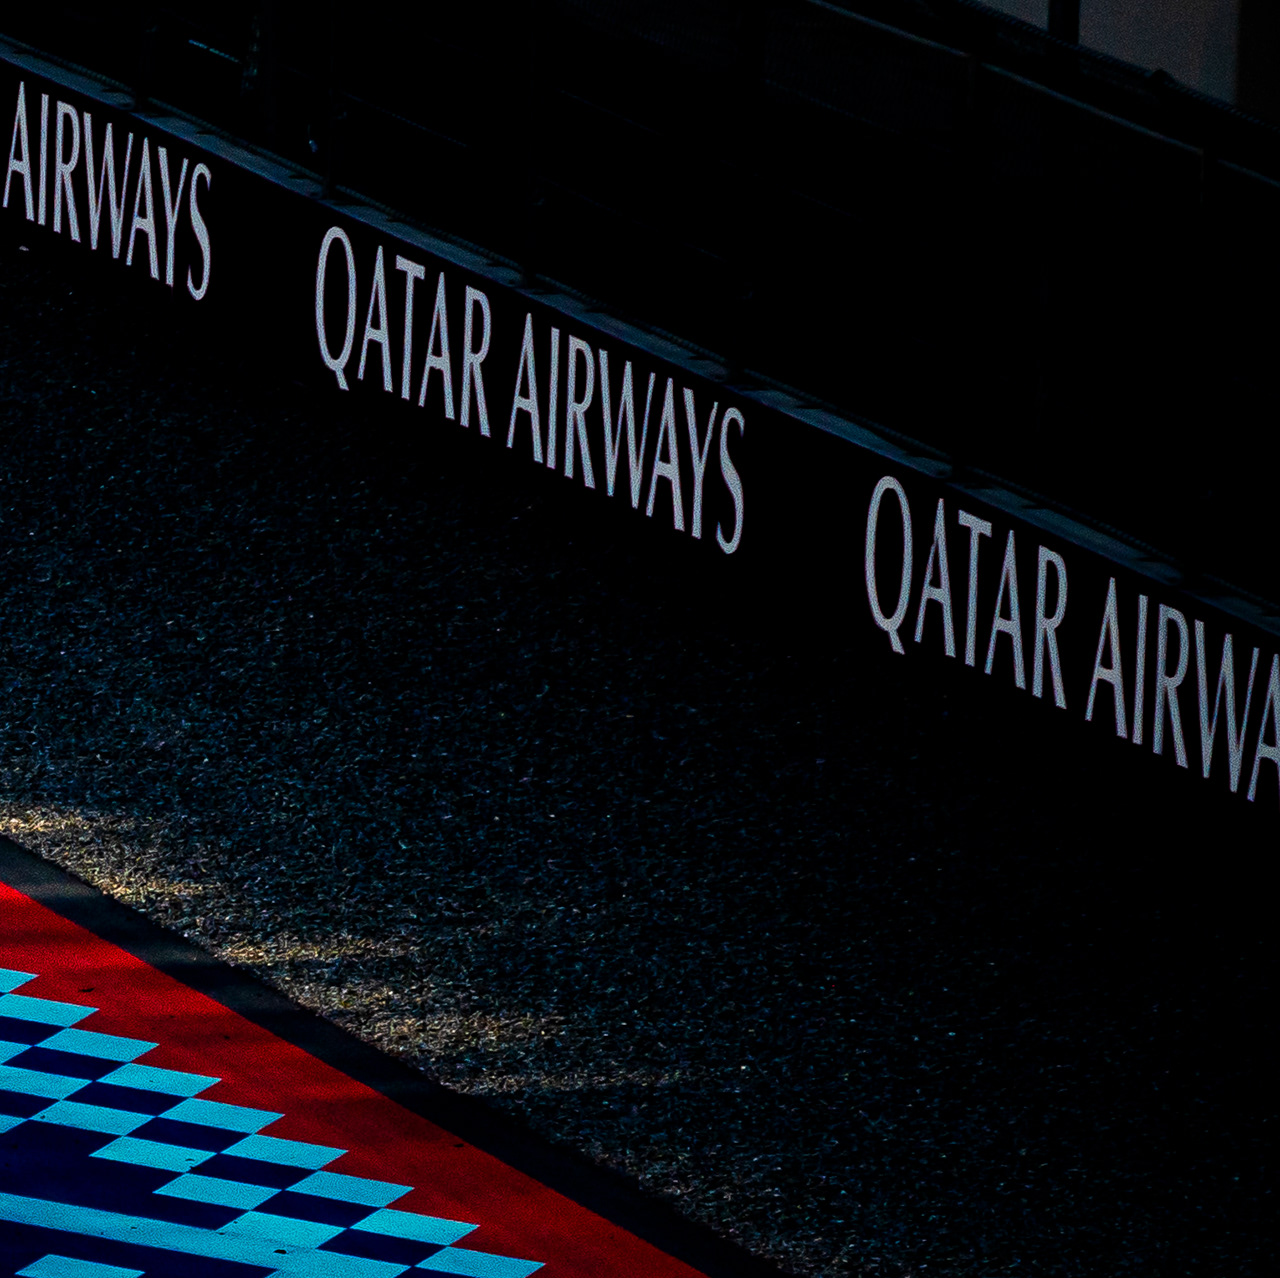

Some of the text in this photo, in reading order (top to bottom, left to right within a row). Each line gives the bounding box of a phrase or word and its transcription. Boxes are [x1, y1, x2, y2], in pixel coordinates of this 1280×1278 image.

[2, 81, 212, 302] AIRWAYS
[315, 226, 745, 555] QATAR AIRWAYS
[865, 475, 1068, 710] QATAR
